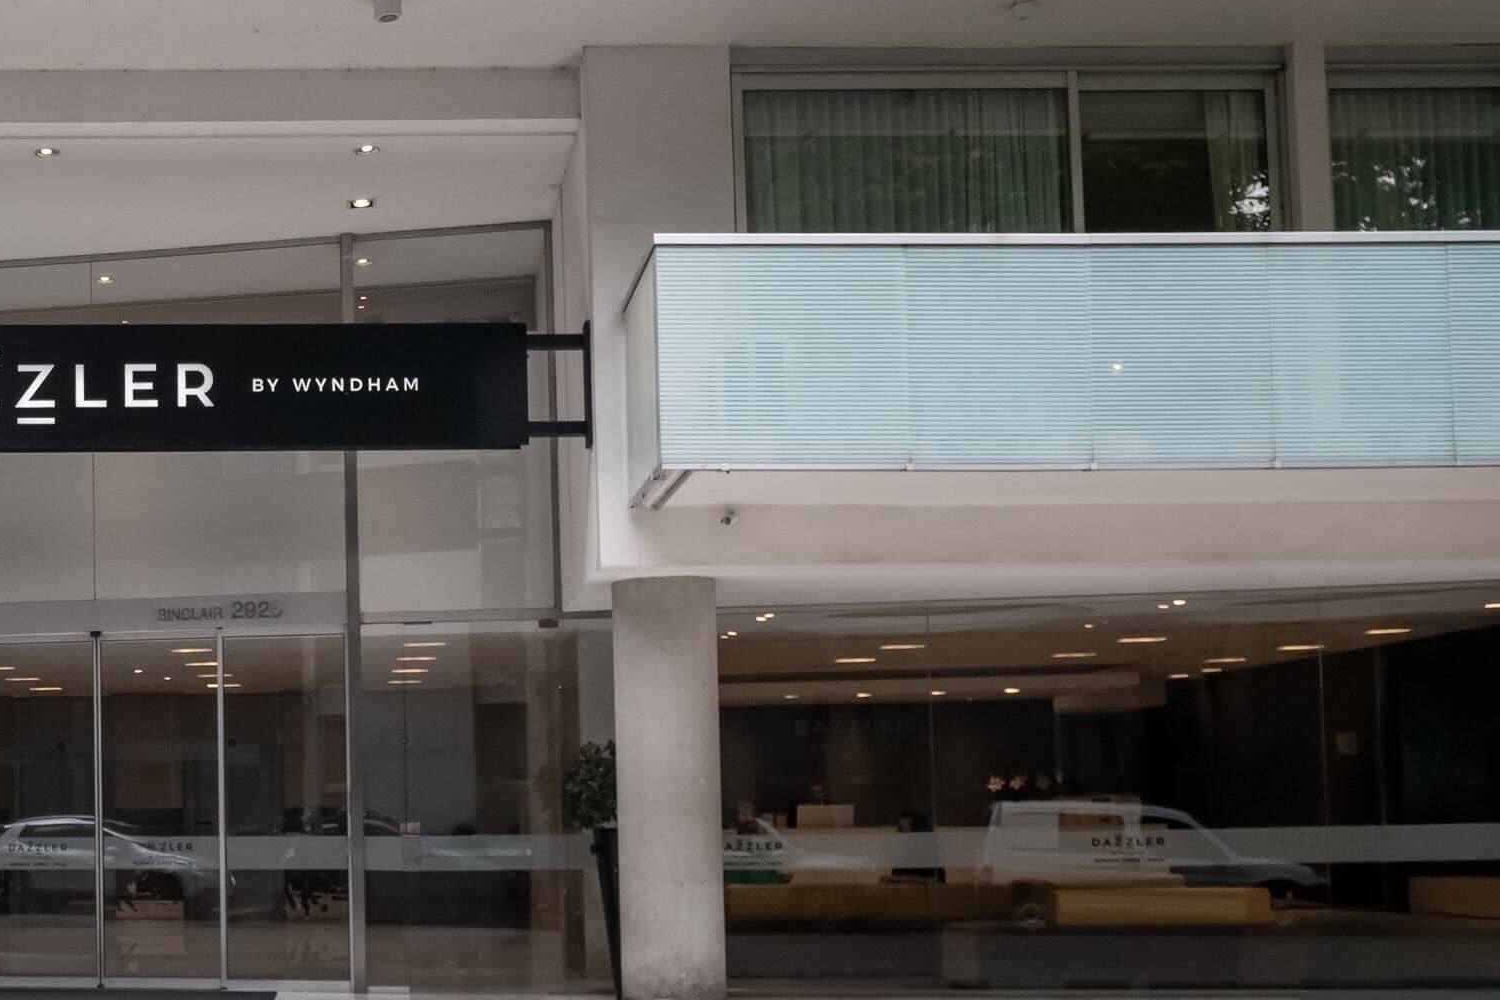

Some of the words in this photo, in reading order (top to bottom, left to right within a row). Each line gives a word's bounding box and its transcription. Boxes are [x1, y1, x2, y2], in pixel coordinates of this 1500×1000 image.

[252, 378, 279, 392] BY
[292, 377, 419, 392] WYNDHAM
[157, 606, 223, 621] SINCLAIR
[8, 841, 68, 854] DAZZLER
[724, 841, 783, 852] AZZLER
[1092, 835, 1164, 849] DAZZLER
